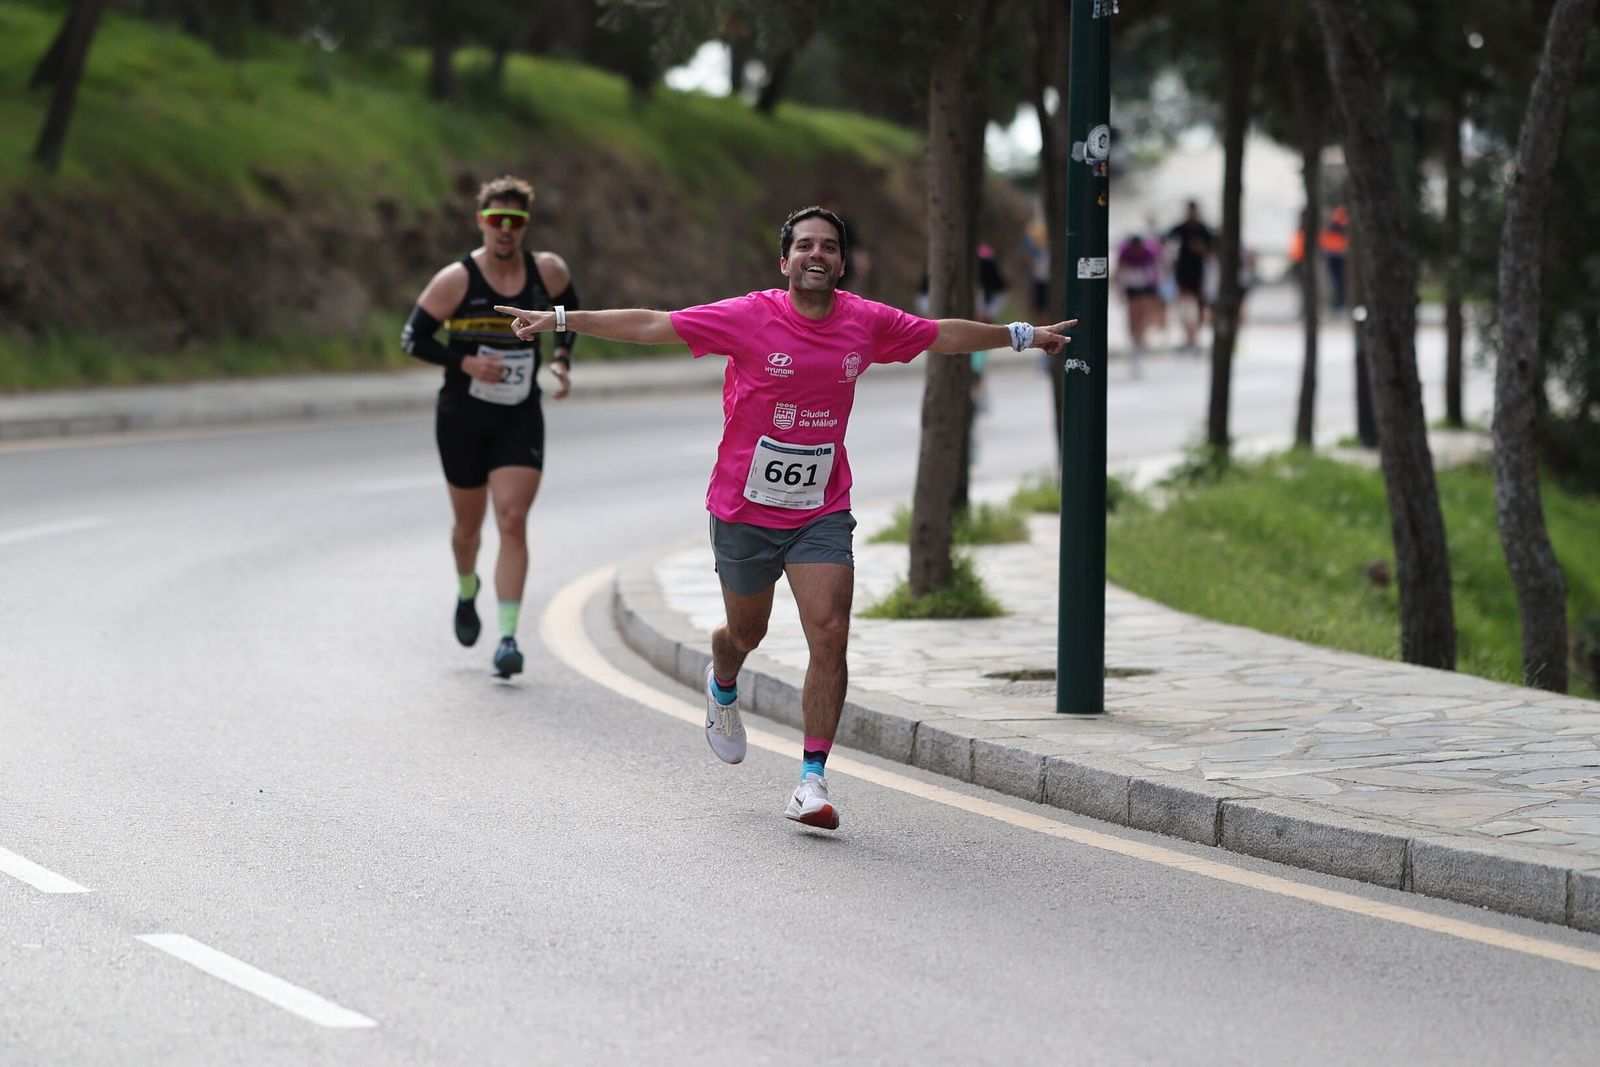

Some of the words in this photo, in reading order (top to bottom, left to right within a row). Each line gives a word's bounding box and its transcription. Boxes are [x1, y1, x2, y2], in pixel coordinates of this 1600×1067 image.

[499, 364, 526, 385] 25
[765, 366, 795, 375] HYUNDAI
[800, 409, 830, 418] Ciudad
[798, 419, 810, 427] de
[811, 418, 838, 428] Málaga
[764, 460, 818, 487] 661
